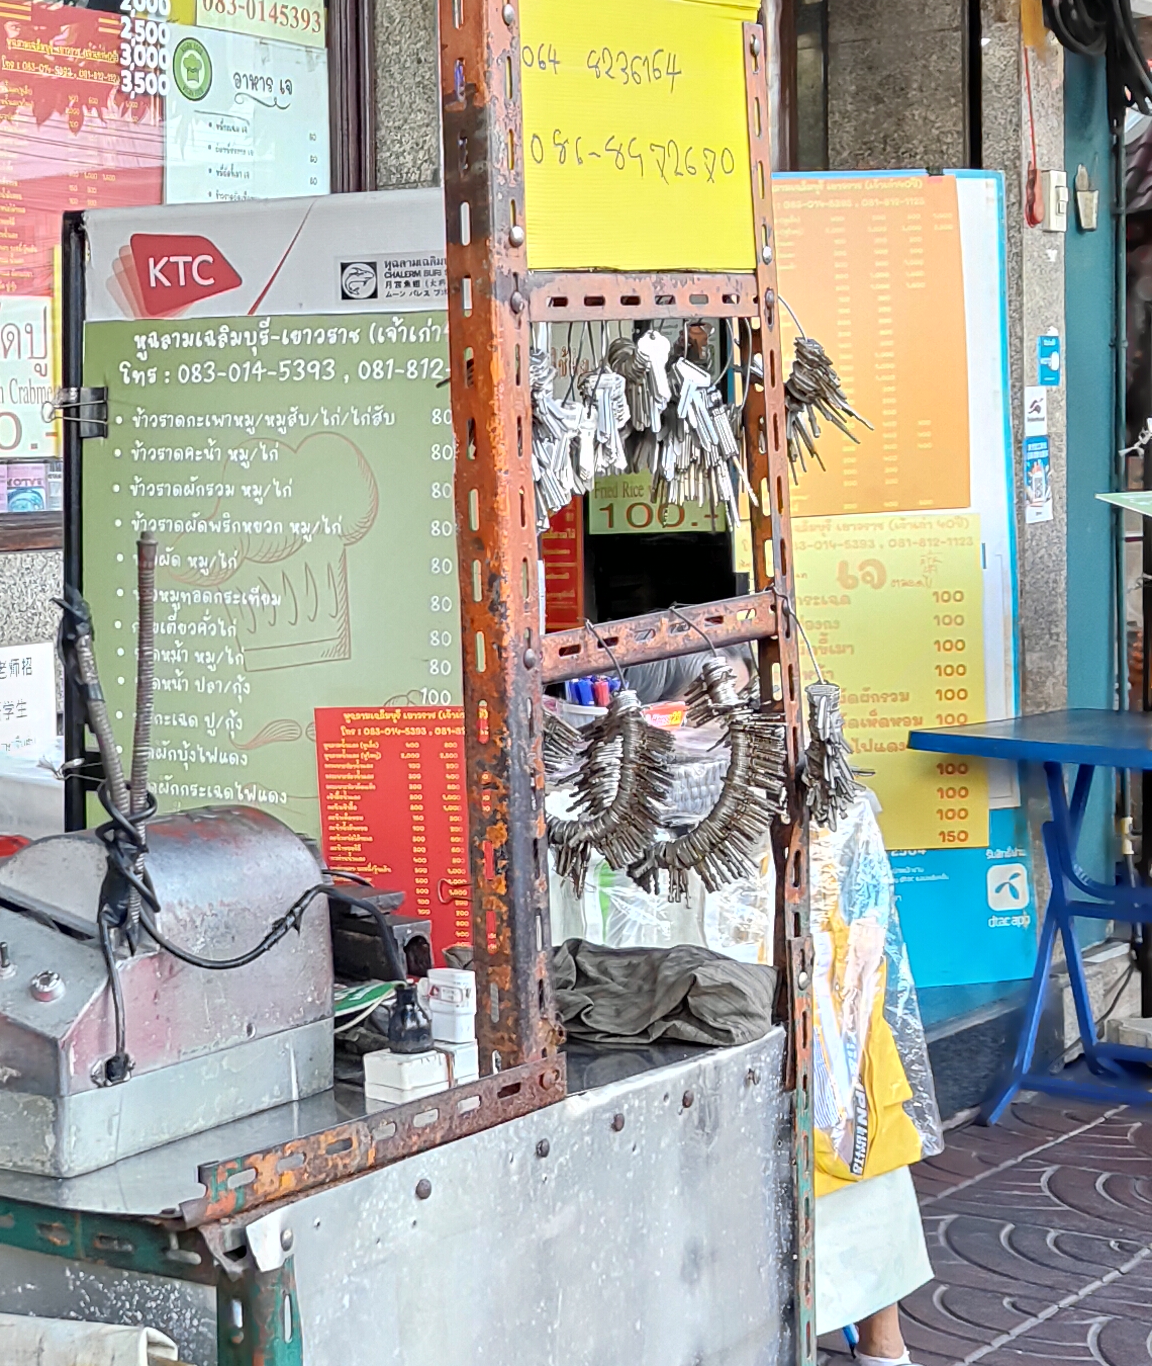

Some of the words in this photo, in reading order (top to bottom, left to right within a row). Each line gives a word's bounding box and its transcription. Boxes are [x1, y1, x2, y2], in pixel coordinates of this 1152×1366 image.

[119, 15, 172, 48] 2,500
[119, 42, 172, 76] 3,000
[522, 43, 561, 75] 064
[119, 69, 172, 101] 3,500
[233, 72, 274, 93] อาหาร
[279, 78, 294, 96] เจ
[147, 254, 216, 288] KTC
[384, 255, 446, 272] หูฉลามเฉลิม
[133, 317, 361, 362] หูฉลามเฉลิมบุรี-เยาวราช
[369, 315, 449, 343] (เจ้าเก่า
[118, 362, 158, 387] โทร
[176, 359, 337, 384] 083-014-5393
[357, 357, 450, 382] 081-812-
[8, 378, 57, 405] Crabme
[431, 407, 452, 426] 80
[130, 438, 223, 462] ข้าวราดคะน้า
[227, 442, 280, 469] หมู/ไก่
[430, 443, 453, 462] 80
[129, 475, 235, 499] ข้าวราดผักรวม
[241, 479, 293, 505] หมู/ไก่
[430, 482, 453, 500] 80
[622, 481, 645, 498] Rice
[289, 515, 343, 543] หมู/ไก่
[430, 519, 453, 537] 80
[796, 538, 875, 550] 3-014-5393
[186, 550, 238, 577] หมู/ไก่
[430, 557, 453, 575] 80
[836, 558, 887, 590] เจ
[429, 595, 453, 613] 80
[932, 589, 965, 604] 100
[933, 613, 965, 627] 100
[429, 630, 452, 648] 80
[933, 638, 966, 652] 100
[194, 645, 246, 672] หมู/ไก่
[428, 659, 452, 677] 80
[934, 663, 967, 677] 100
[194, 674, 252, 704] ปลา/กุ้ง
[420, 686, 453, 706] 100
[935, 688, 968, 702] 100
[204, 708, 244, 740] ปู/กุ้ง
[434, 725, 465, 736] 081-81
[935, 712, 969, 727] 100
[148, 739, 249, 771] ดผักบุ้งไฟแดง
[936, 762, 969, 776] 100
[147, 775, 288, 804] ดผักกระเฉดไฟแดง
[936, 786, 969, 800] 100
[936, 807, 969, 821] 100
[938, 829, 969, 843] 150
[987, 914, 1012, 928] dtac
